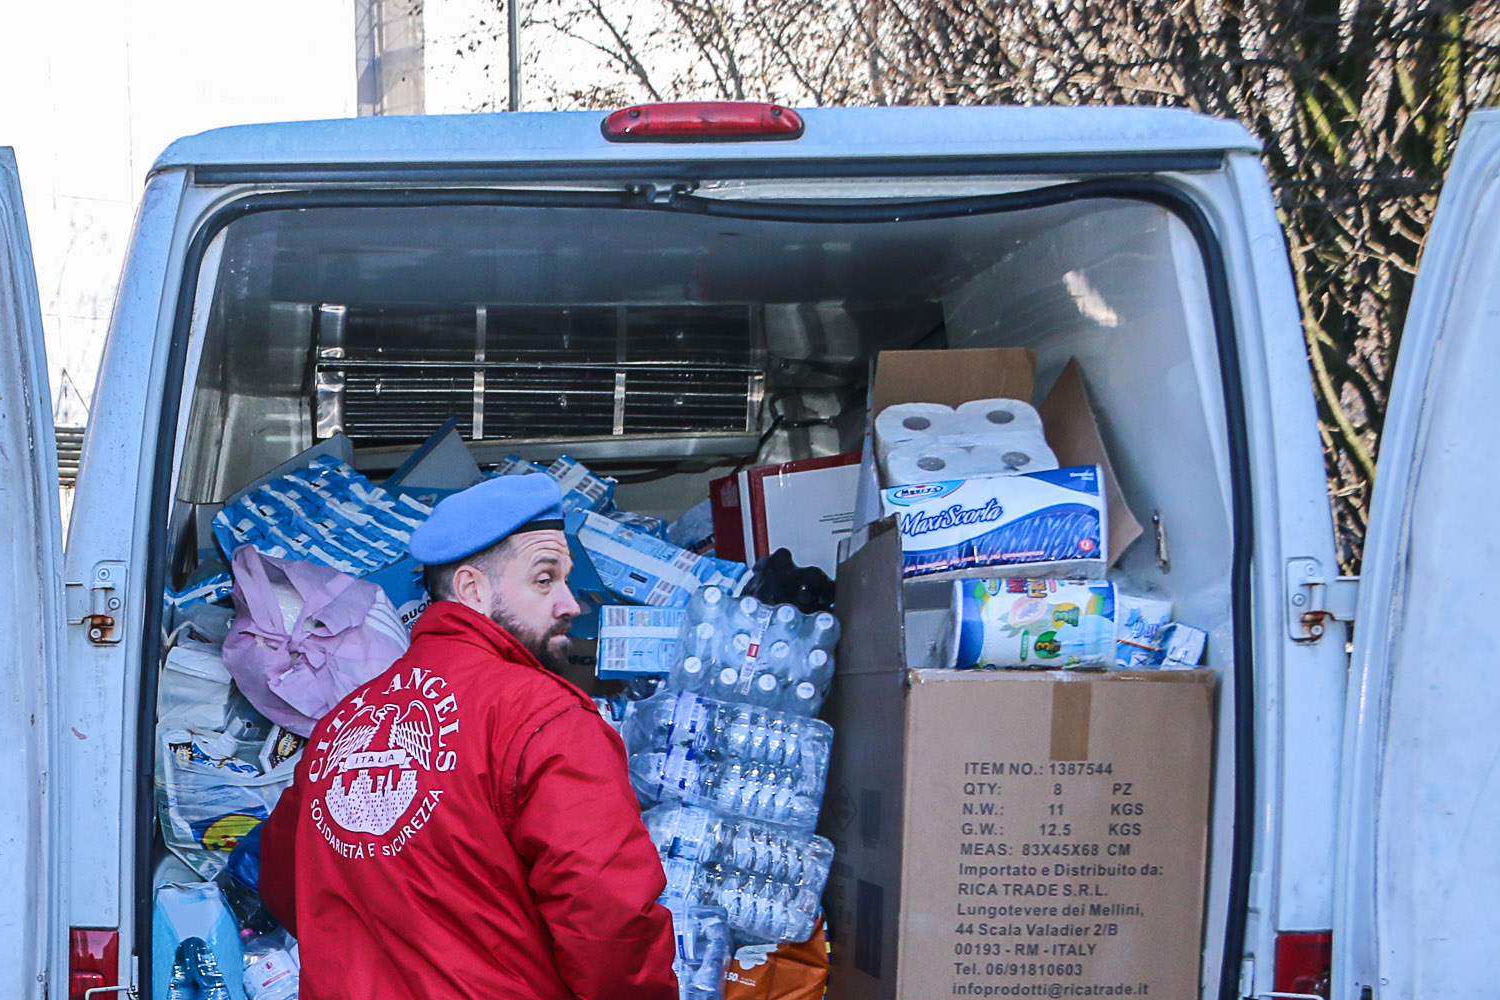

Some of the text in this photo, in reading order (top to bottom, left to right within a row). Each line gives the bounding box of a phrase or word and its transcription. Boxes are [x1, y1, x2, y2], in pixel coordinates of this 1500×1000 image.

[308, 667, 460, 783] CITY ANGELS
[354, 754, 395, 764] ITALIA
[964, 762, 1113, 775] ITEM NO.: 1387544
[963, 782, 1132, 796] QTY: 8 PZ
[962, 803, 1144, 816] N.W.: 11 KGS
[310, 788, 444, 859] SOLIDARIETÀ E SICUREZZA
[961, 823, 1142, 836] G.W.: 12.5 KGS
[960, 843, 1131, 856] MEAS: 83X45X68 CM
[959, 863, 1164, 879] Importato e Distribuito da:
[958, 883, 1109, 896] RICA TRADE S.R.L.
[957, 903, 1145, 919] Lungotevere dei Mellini,
[955, 923, 1119, 936] 44 Scala Valadier 2/B
[954, 943, 1001, 956] 00193
[1014, 944, 1039, 956] RM
[1052, 943, 1098, 957] ITALY
[953, 962, 1083, 976] Tel. 06/91810603
[952, 982, 1149, 999] infoprodotti@ricatrade.it
